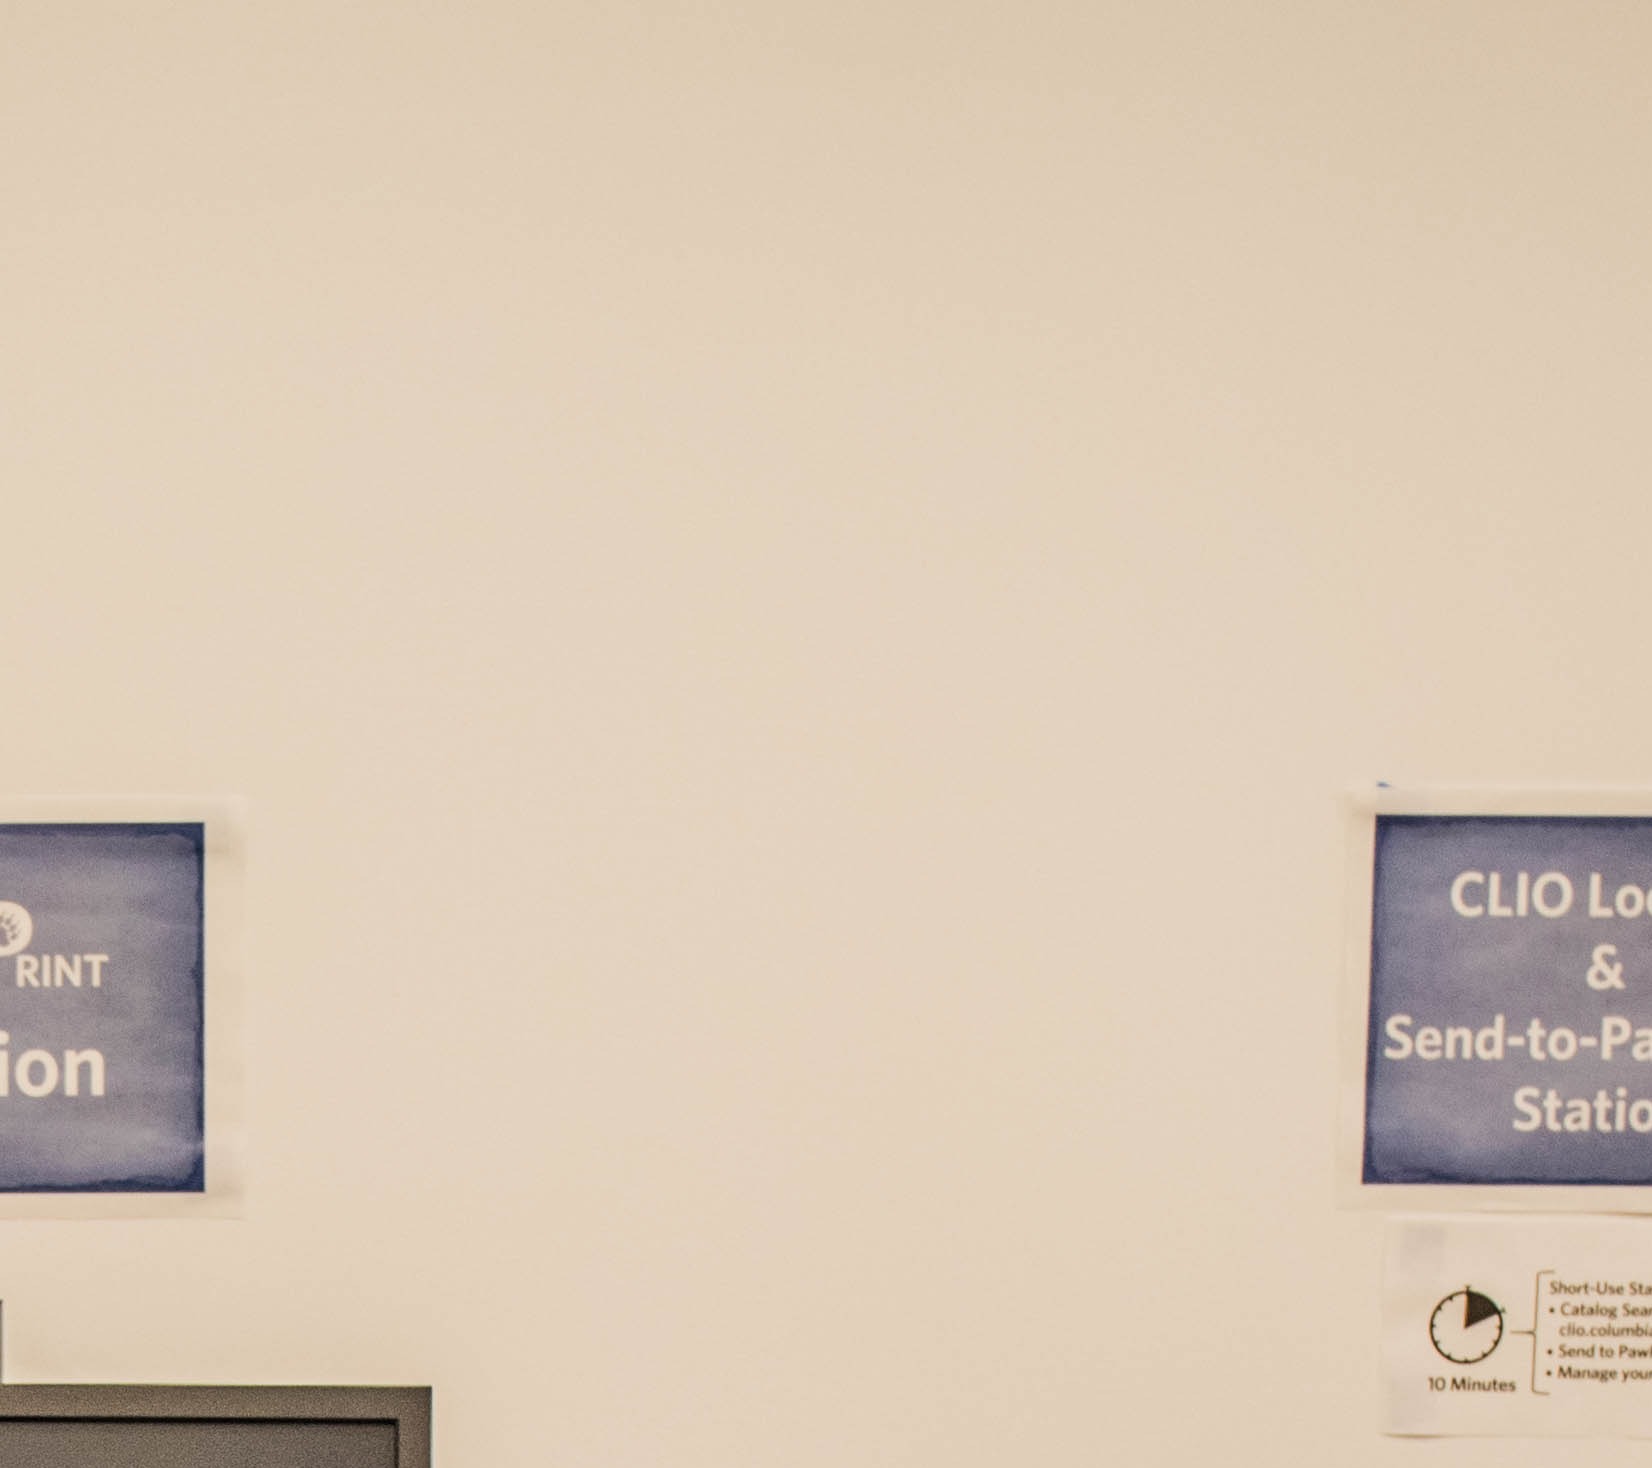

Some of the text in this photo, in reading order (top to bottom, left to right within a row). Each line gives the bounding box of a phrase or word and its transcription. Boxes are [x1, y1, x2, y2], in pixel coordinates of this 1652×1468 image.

[1450, 870, 1574, 919] CLIO
[1585, 943, 1627, 991] &
[1549, 1281, 1624, 1296] Short-Use
[1560, 1303, 1617, 1321] Catalog
[1558, 1344, 1596, 1359] Send
[1599, 1345, 1614, 1359] to
[1557, 1365, 1617, 1384] Manage
[1428, 1376, 1517, 1393] 10 Minutes
